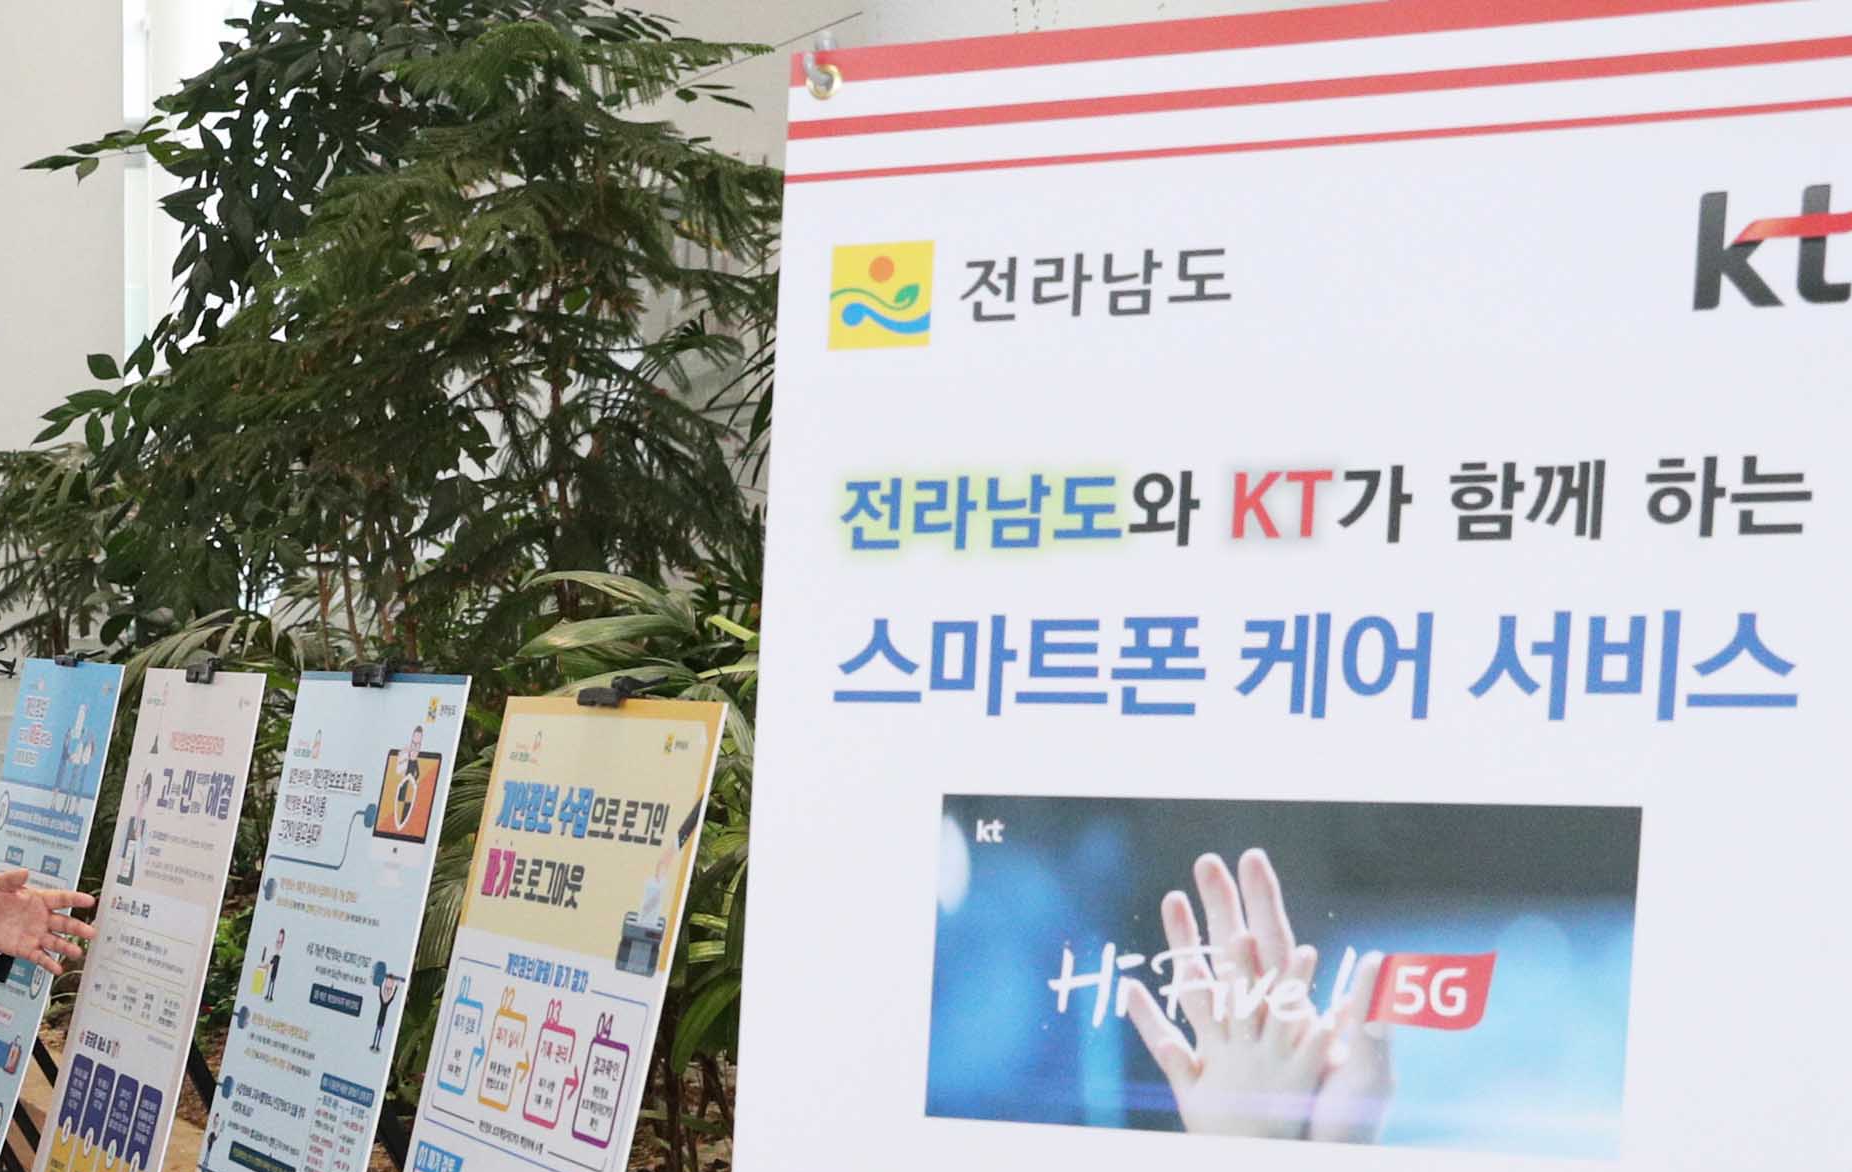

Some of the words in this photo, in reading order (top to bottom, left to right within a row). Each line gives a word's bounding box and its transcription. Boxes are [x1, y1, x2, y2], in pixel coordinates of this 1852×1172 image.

[1693, 184, 1852, 311] kt
[961, 249, 1231, 322] 전라남도
[840, 470, 1199, 550] 전라남도와
[1231, 464, 1412, 545] KT가
[1450, 460, 1605, 540] 함께
[1646, 456, 1812, 537] 하는
[834, 615, 1206, 716] 스마트폰
[1236, 612, 1433, 719] 케어
[1469, 610, 1797, 720] 서비스
[495, 780, 562, 834] 개인정보
[558, 782, 621, 841] 수집으로
[623, 800, 671, 846] 로그인
[976, 817, 1003, 842] kt
[524, 858, 586, 910] 로그아웃
[544, 997, 564, 1026] 03
[1393, 967, 1467, 1017] 5G
[594, 1011, 615, 1041] 04
